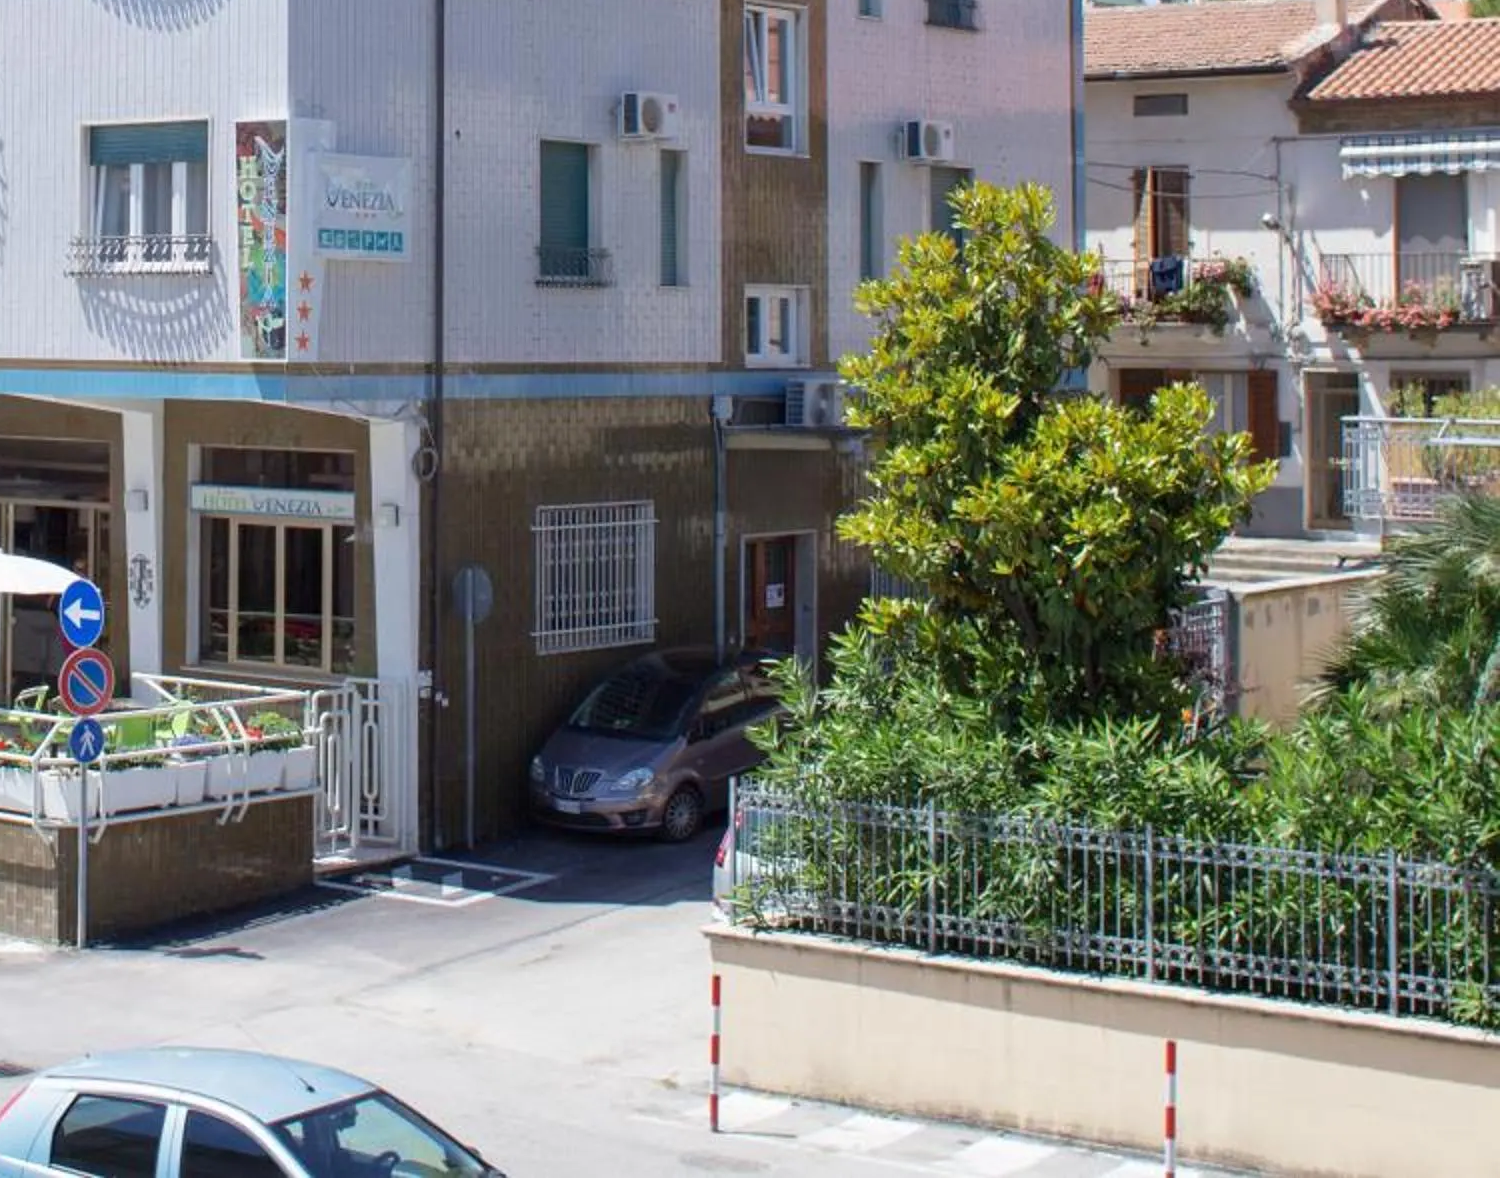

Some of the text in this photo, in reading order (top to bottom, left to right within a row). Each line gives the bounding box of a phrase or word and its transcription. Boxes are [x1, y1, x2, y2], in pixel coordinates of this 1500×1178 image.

[239, 156, 258, 269] HOTEL
[254, 135, 285, 308] VENEZIA
[324, 183, 397, 211] VENEZIA
[251, 494, 322, 515] VENEZIA
